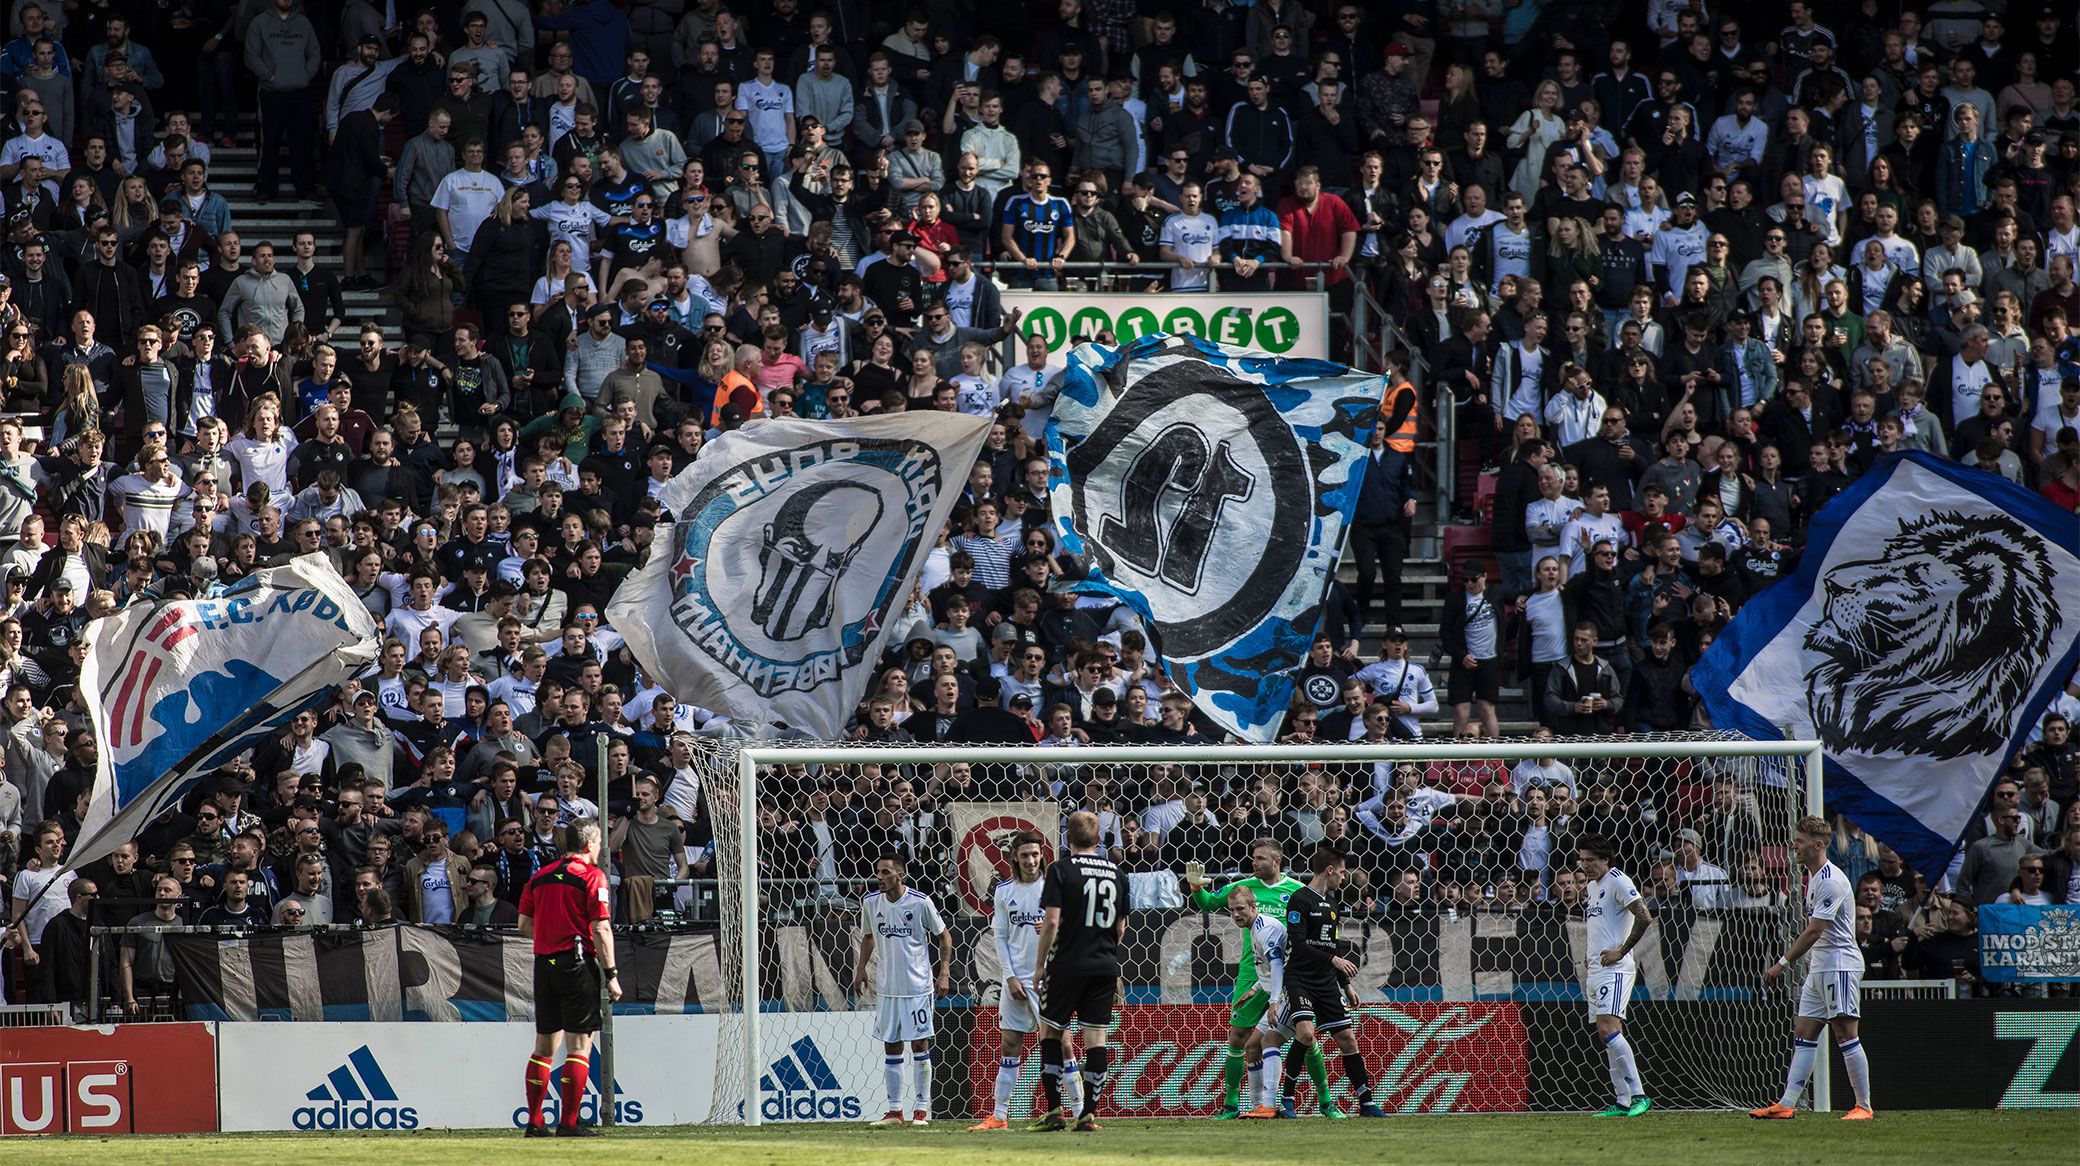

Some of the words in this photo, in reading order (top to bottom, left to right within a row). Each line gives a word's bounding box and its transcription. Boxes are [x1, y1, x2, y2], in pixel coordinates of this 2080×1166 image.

[756, 99, 784, 111] Carlsberg
[1023, 220, 1055, 234] Carlsberg
[1674, 245, 1703, 257] Carlsberg
[1030, 314, 1288, 346] UNIBET
[384, 693, 396, 703] 12
[422, 878, 450, 891] Carlsbe
[1082, 878, 1118, 928] 13
[1257, 902, 1288, 918] arlsberg
[878, 922, 912, 938] Carlsberg
[1982, 934, 2041, 950] IMOD
[1982, 951, 2080, 967] KARANT
[218, 924, 878, 1021] URAN
[1599, 985, 1608, 1001] 9
[1827, 983, 1835, 1002] 7
[911, 1008, 927, 1026] 10
[512, 1096, 644, 1129] addas
[737, 1090, 862, 1121] didas
[292, 1100, 419, 1130] adidas
